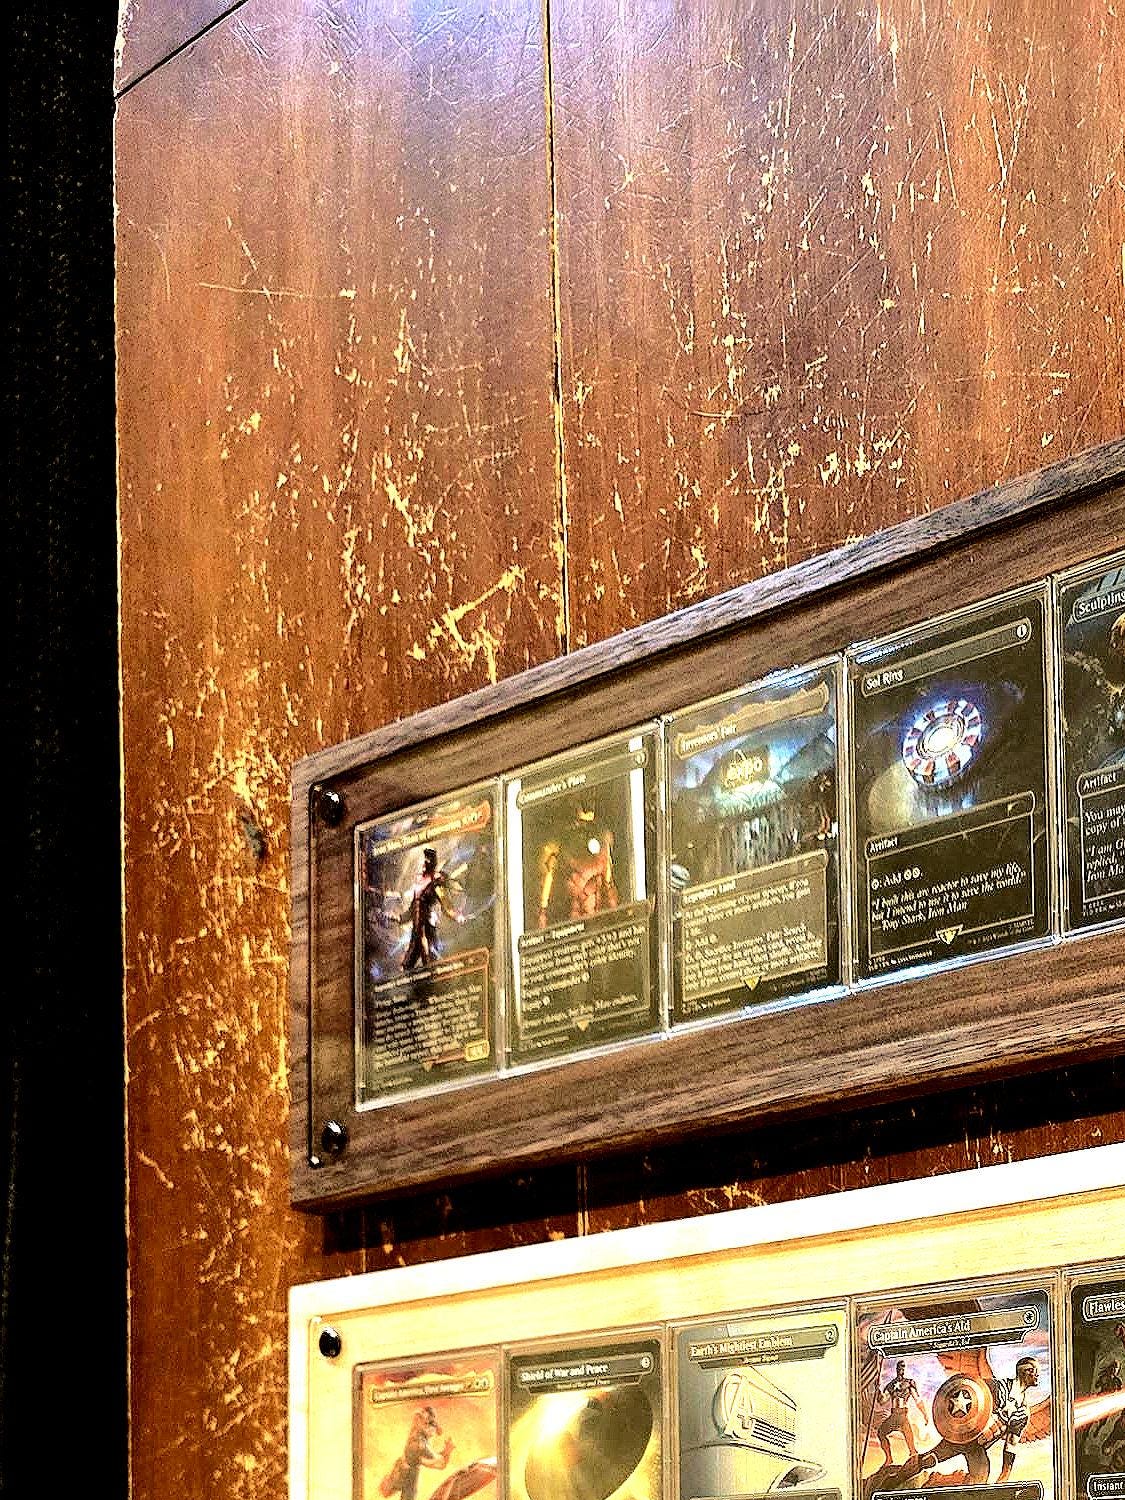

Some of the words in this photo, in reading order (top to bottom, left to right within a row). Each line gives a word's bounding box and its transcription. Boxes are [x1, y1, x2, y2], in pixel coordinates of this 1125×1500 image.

[866, 675, 880, 691] Sol
[882, 670, 903, 685] Ring
[1082, 772, 1117, 790] Artifact
[869, 837, 898, 853] Artifact
[873, 1328, 907, 1345] Captain
[908, 1322, 952, 1338] America's
[953, 1318, 970, 1333] Aid
[1093, 1480, 1124, 1491] Instant
